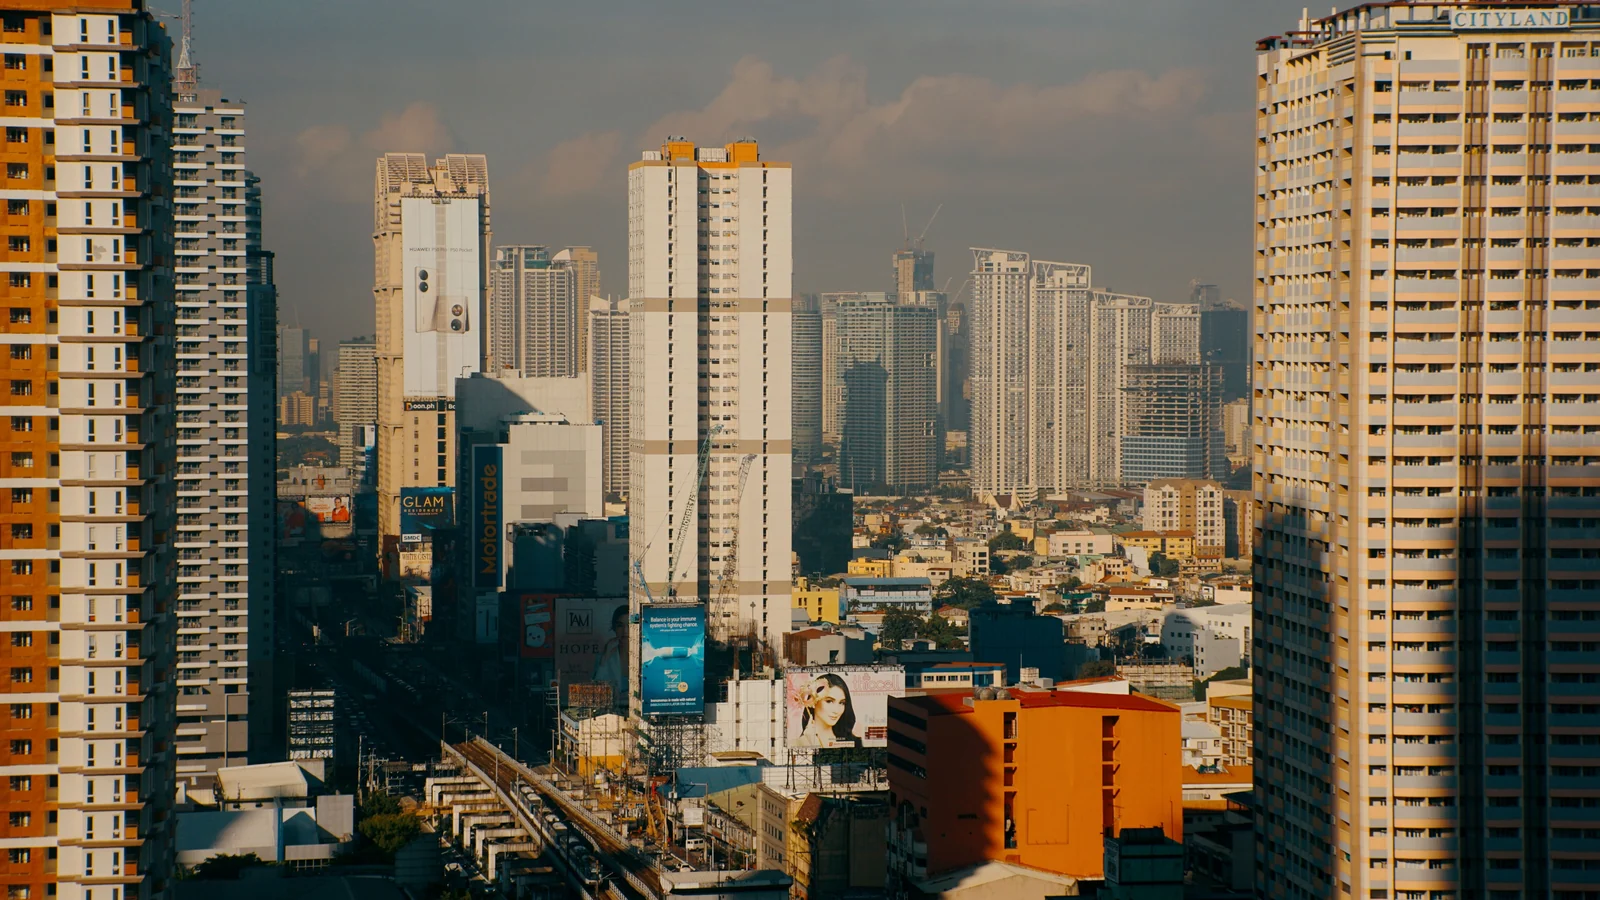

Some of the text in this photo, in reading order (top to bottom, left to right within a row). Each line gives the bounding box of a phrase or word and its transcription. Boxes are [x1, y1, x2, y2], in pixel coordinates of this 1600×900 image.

[1454, 11, 1568, 27] CITYLAND
[403, 496, 444, 507] GLAM
[480, 464, 498, 574] Motortrade
[559, 644, 600, 654] HOPE
